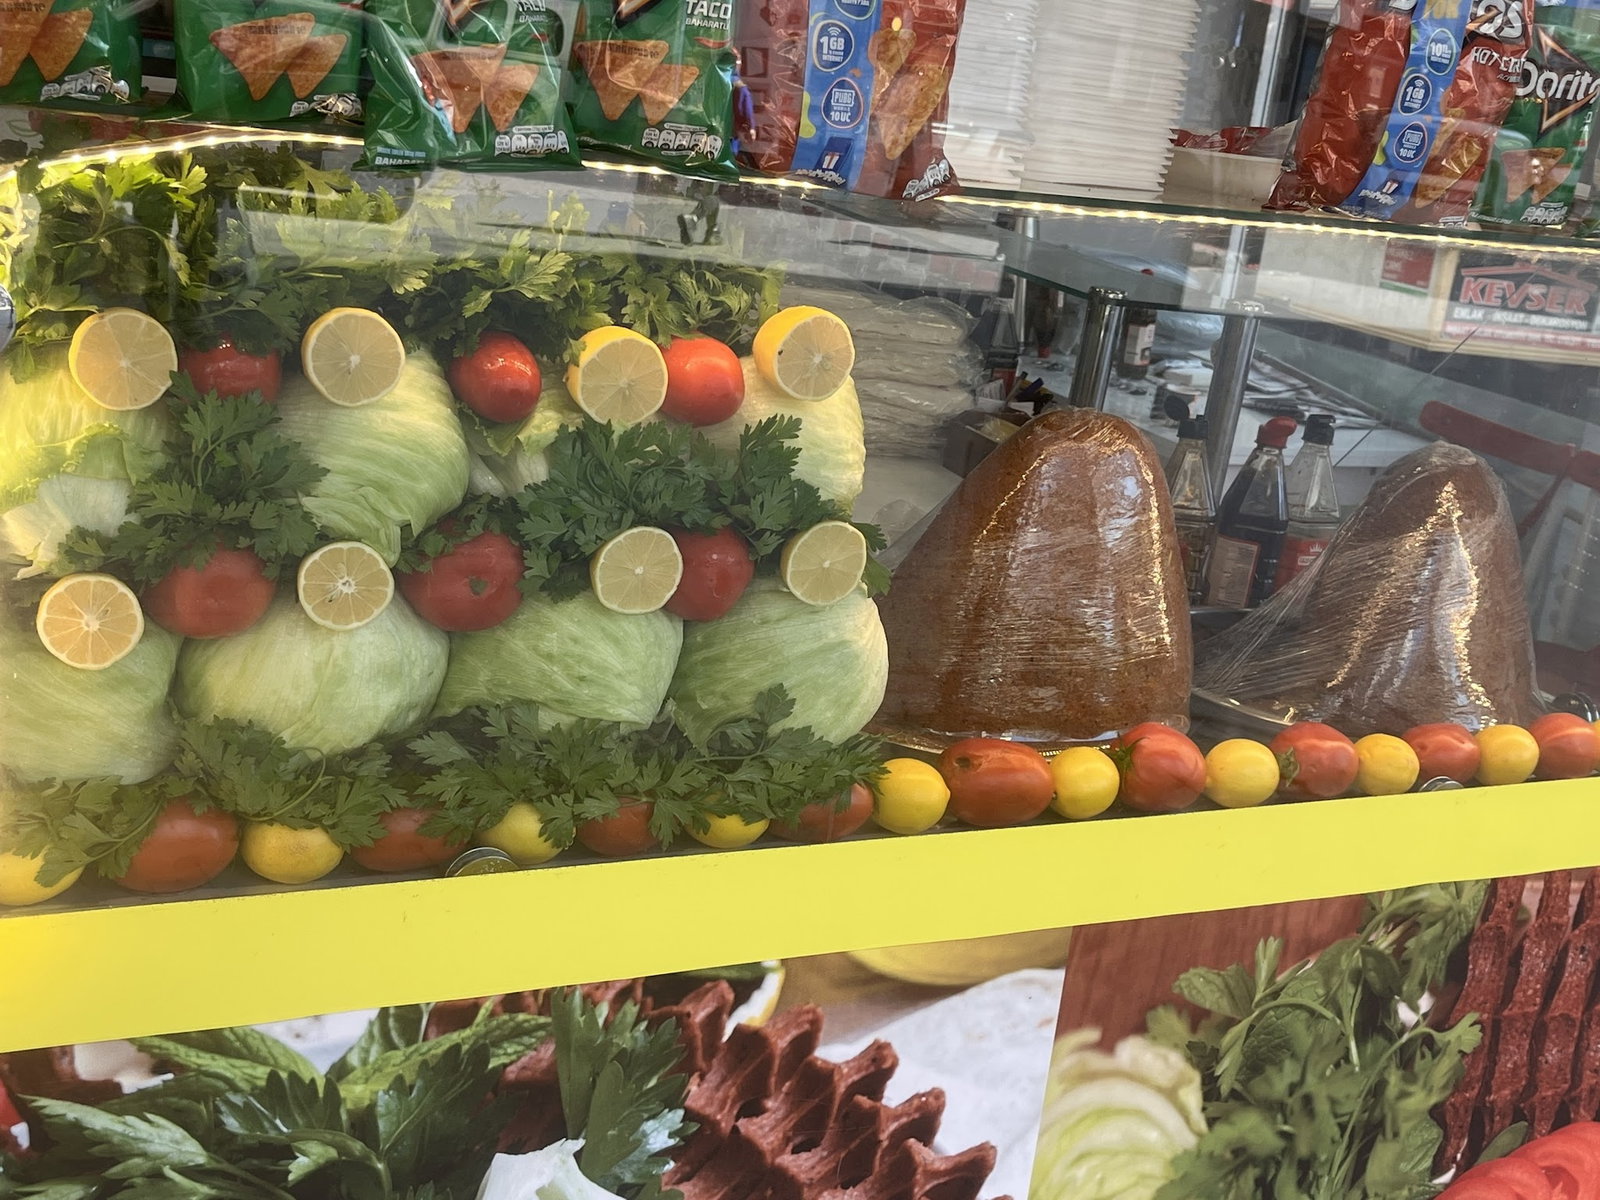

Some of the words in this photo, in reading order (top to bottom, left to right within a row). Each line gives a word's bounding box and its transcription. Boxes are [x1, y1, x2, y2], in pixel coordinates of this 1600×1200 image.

[685, 0, 731, 20] TACO
[1471, 46, 1500, 67] HOT
[834, 91, 852, 104] PUBG
[1459, 277, 1590, 316] KEVSER
